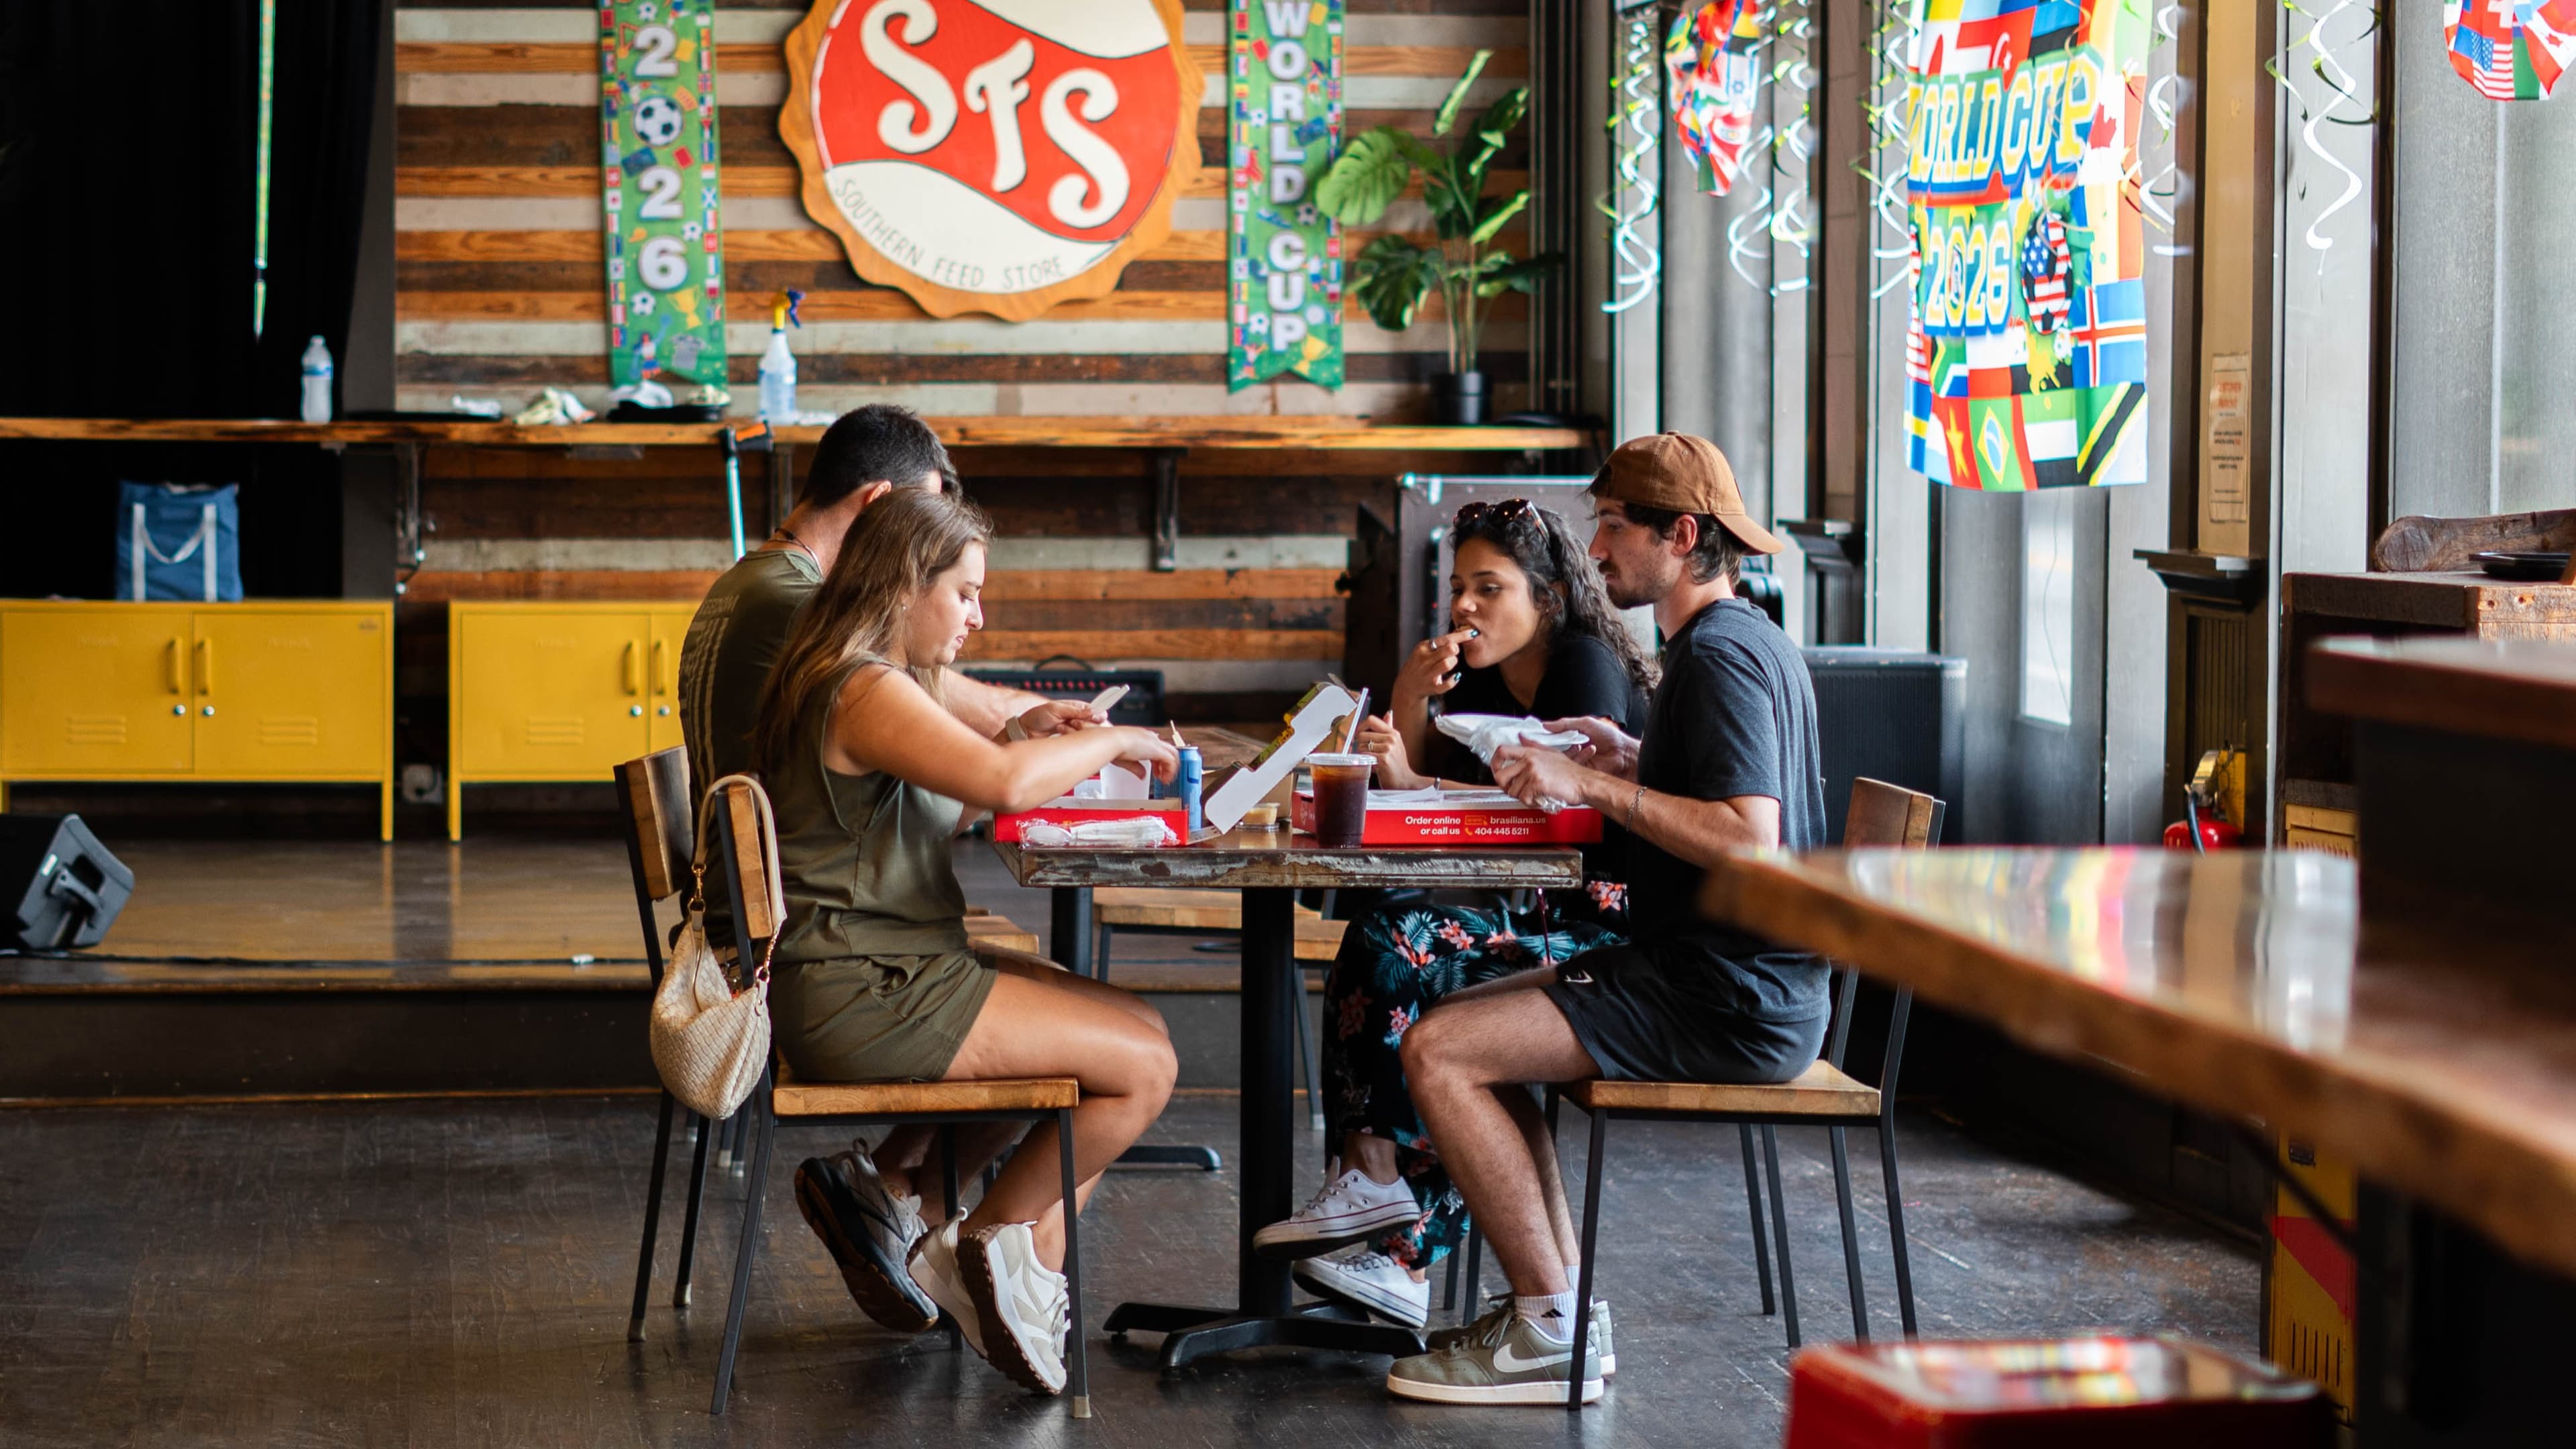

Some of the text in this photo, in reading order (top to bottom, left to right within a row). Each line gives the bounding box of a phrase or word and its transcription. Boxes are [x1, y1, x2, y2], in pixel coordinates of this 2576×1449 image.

[2000, 52, 2102, 176] CUP
[1264, 0, 1311, 352] WORLD CUP
[835, 178, 1065, 290] SOUTHERN FEED STORE
[1925, 221, 2012, 328] 2026
[1405, 816, 1432, 824] Order
[1434, 816, 1460, 824] online
[1490, 816, 1546, 824] brasiliana.us
[1432, 826, 1448, 835] call
[1474, 827, 1493, 835] 404
[1493, 827, 1511, 835] 445
[1511, 827, 1529, 835] 5211
